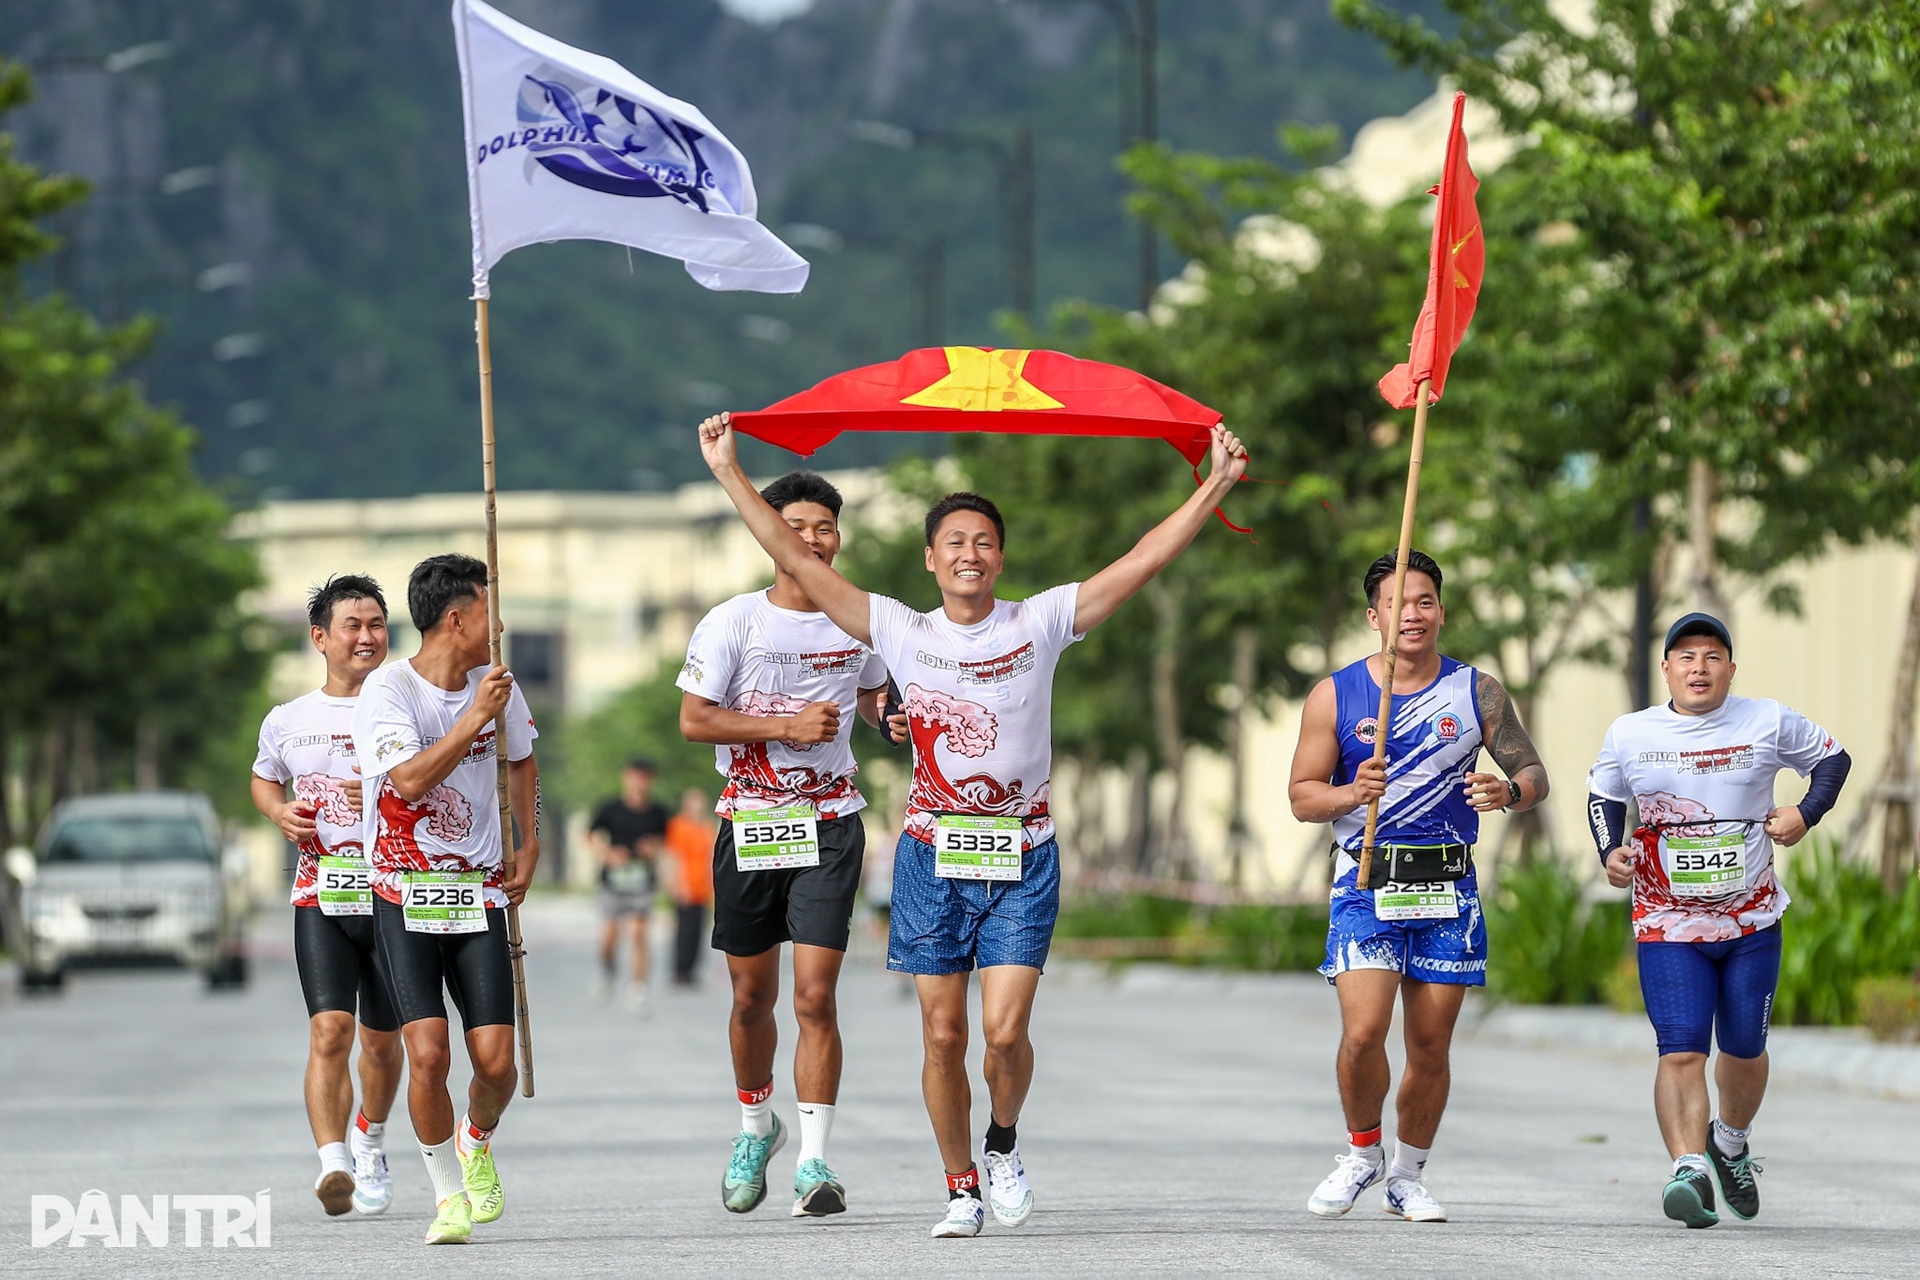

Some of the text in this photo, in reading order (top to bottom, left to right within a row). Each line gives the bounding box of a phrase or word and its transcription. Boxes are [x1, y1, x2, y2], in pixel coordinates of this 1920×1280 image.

[764, 652, 798, 664] AQUA
[916, 650, 957, 671] AQUA
[1018, 660, 1034, 673] CUP
[292, 734, 329, 748] AQUA
[1639, 744, 1754, 763] AQUA WARRIORS
[1692, 767, 1710, 775] RED
[1711, 763, 1735, 774] TIGER
[1735, 761, 1753, 770] CUP
[744, 823, 807, 844] 5325
[947, 833, 1012, 852] 5332
[1676, 851, 1738, 870] 5342
[326, 873, 370, 889] 523
[412, 889, 474, 906] 5236
[751, 1088, 769, 1103] 767
[953, 1174, 973, 1189] 729
